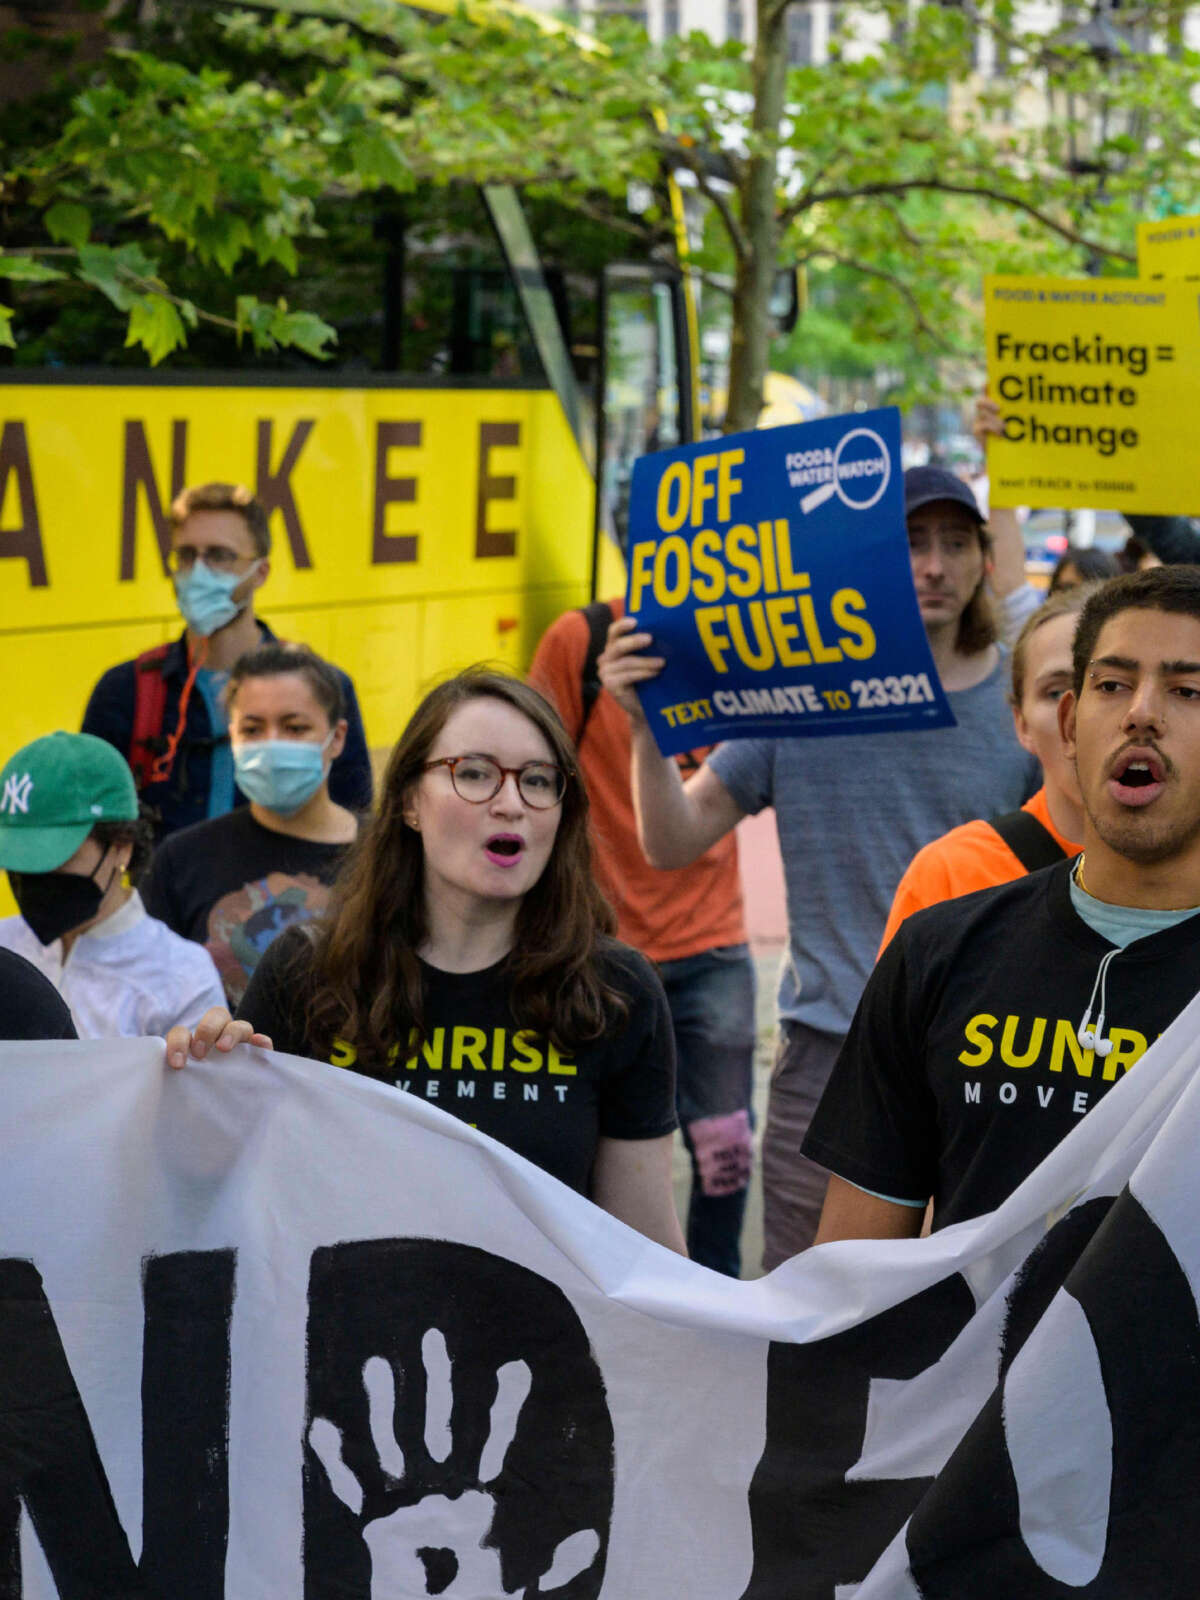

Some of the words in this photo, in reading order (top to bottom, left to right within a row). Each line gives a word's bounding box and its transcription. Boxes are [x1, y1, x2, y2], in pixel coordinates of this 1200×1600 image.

[998, 375, 1138, 407] Climate
[1000, 415, 1139, 456] Change
[657, 448, 745, 533] OFF
[789, 465, 834, 488] WATER
[838, 457, 885, 480] WATCH
[629, 518, 811, 613] FOSSIL
[694, 588, 877, 673] FUELS
[661, 699, 714, 728] TEXT
[713, 685, 823, 717] CLIMATE
[823, 690, 852, 711] TO
[851, 673, 935, 709] 23321
[329, 1026, 578, 1076] SNRISE
[958, 1013, 1150, 1081] SUNR
[395, 1080, 569, 1103] VEMENT
[964, 1081, 1089, 1113] MOVE
